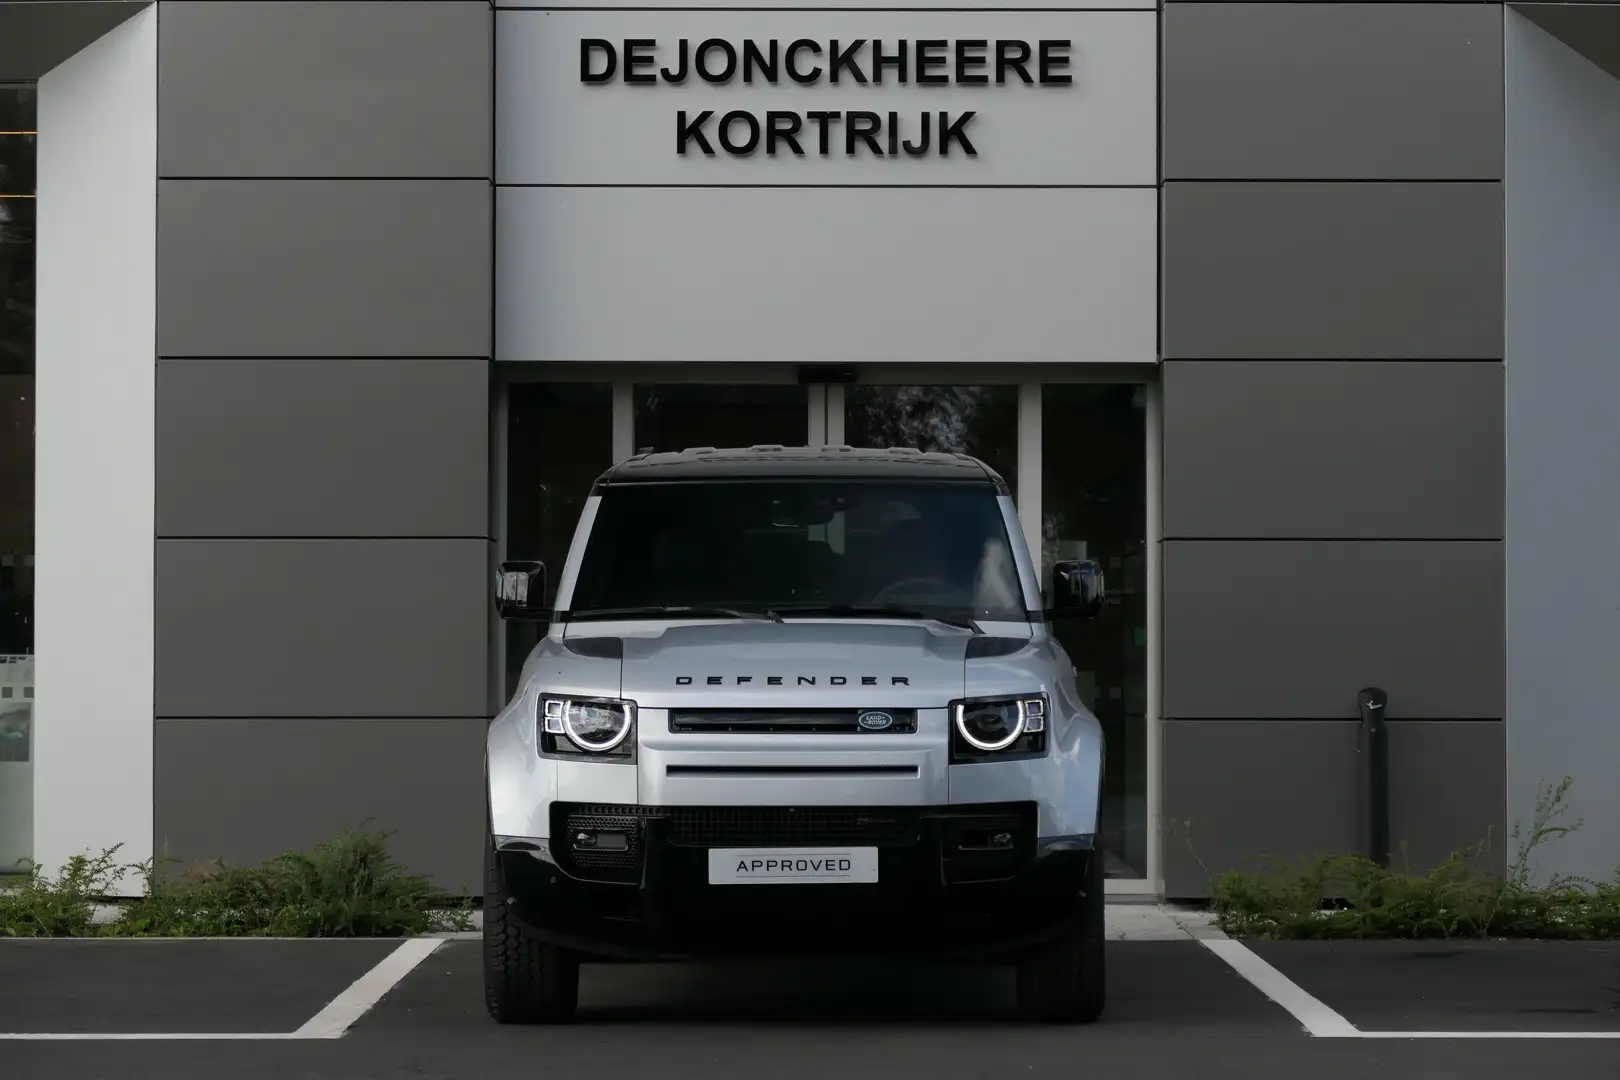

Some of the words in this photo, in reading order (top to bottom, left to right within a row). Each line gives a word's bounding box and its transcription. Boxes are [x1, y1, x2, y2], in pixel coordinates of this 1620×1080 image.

[580, 38, 1074, 85] DEJONCKHEERE
[676, 110, 978, 157] KORTRIJK
[675, 676, 911, 686] DEFENDER
[736, 859, 852, 872] APPROVED
